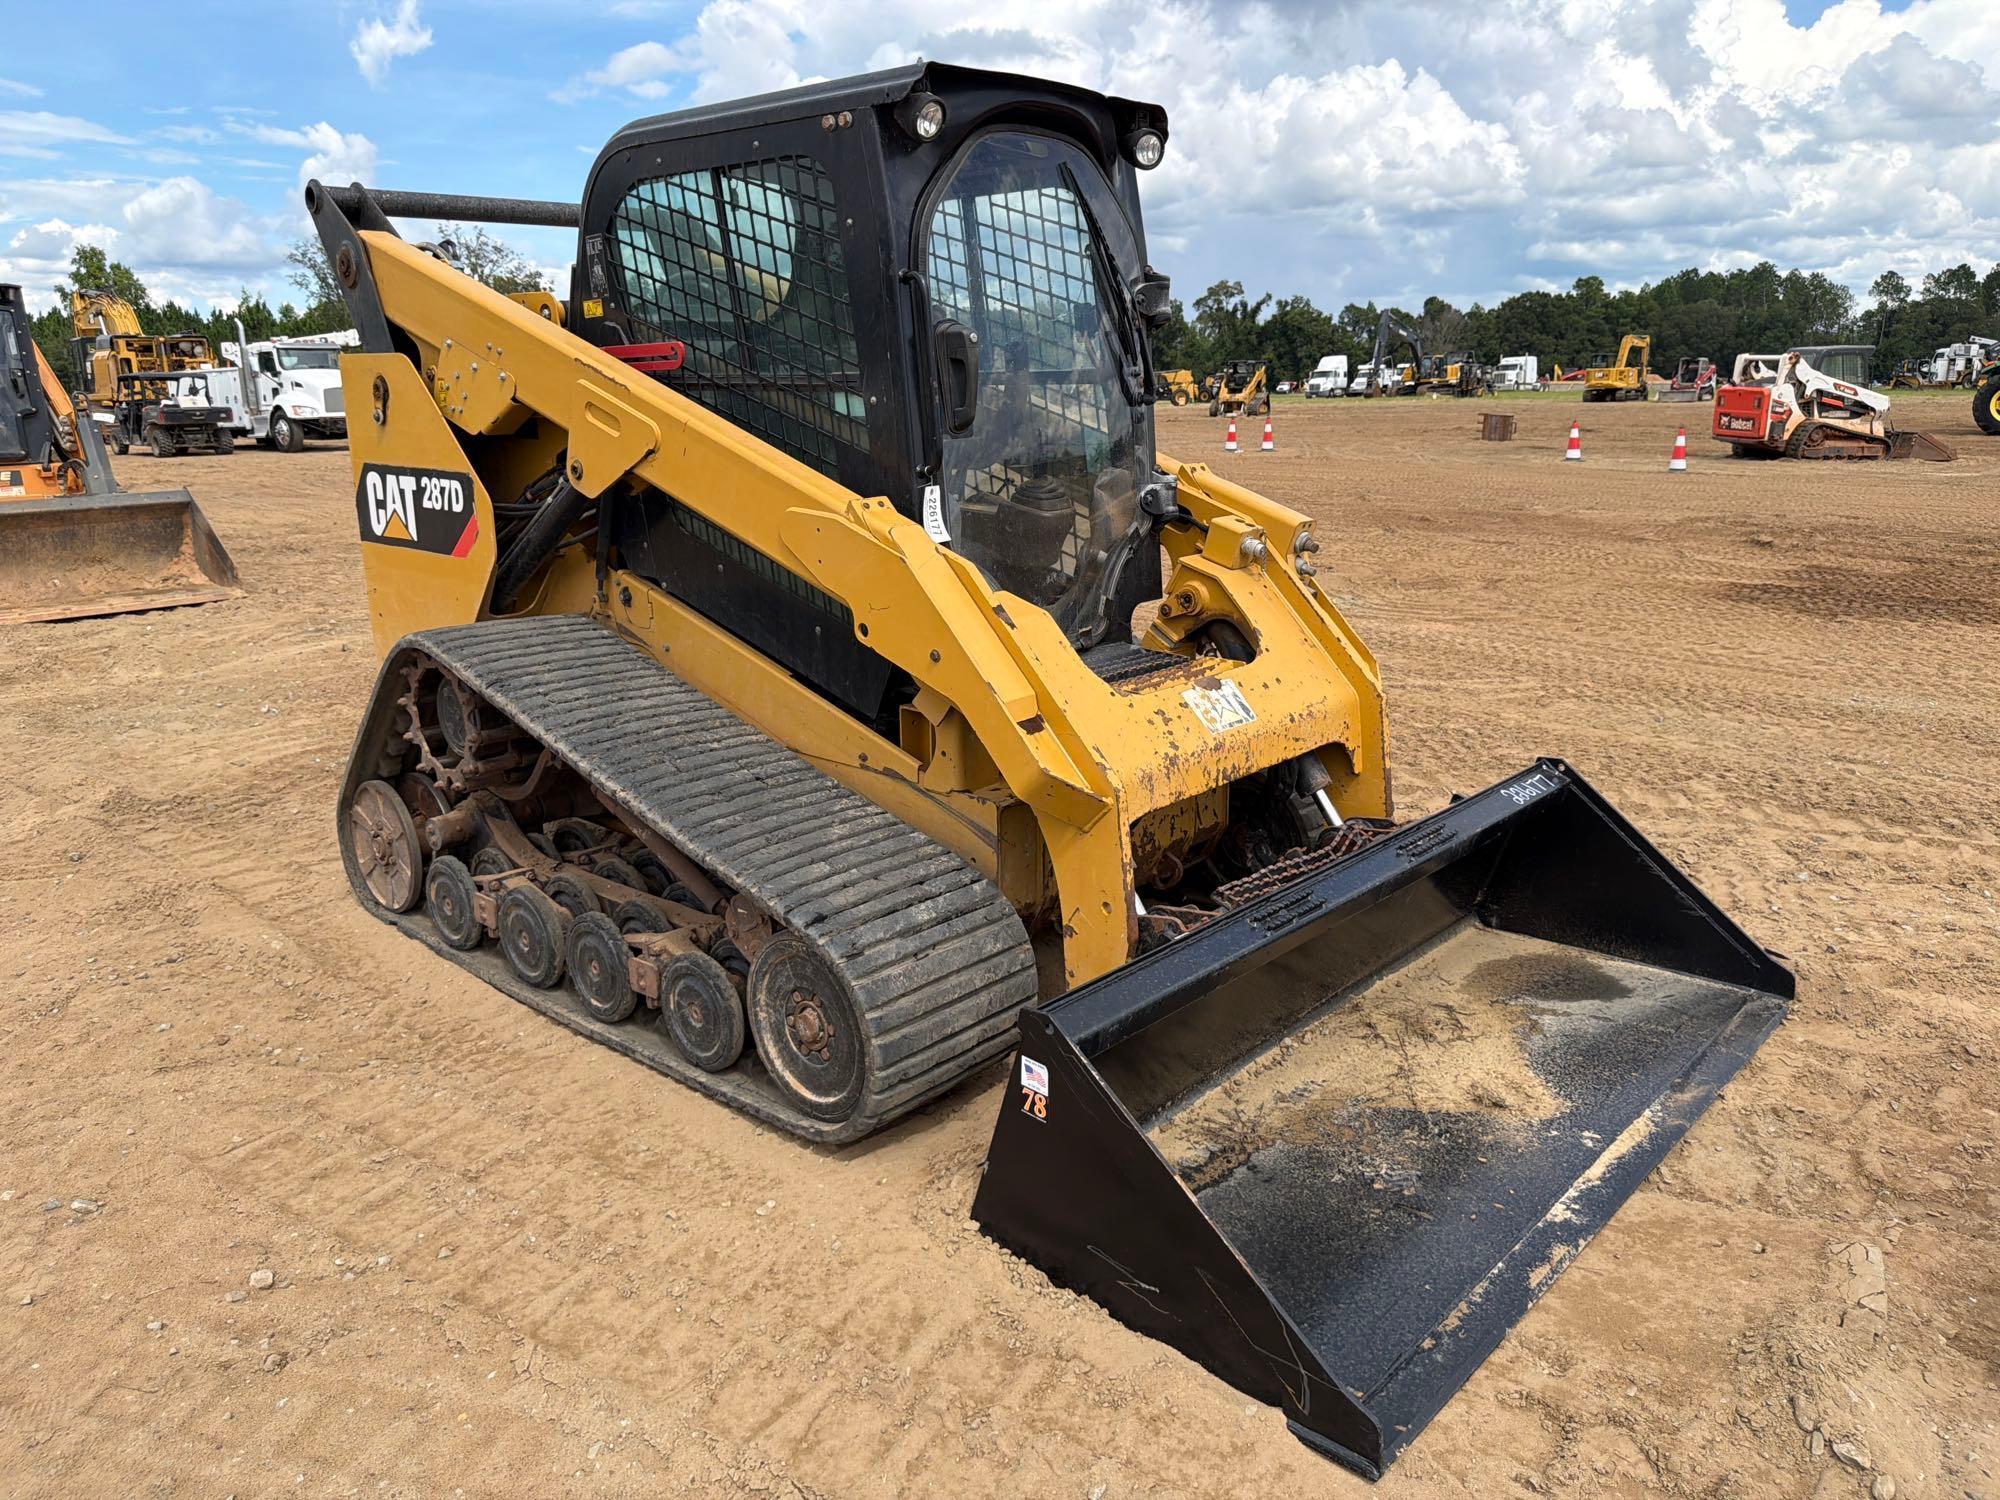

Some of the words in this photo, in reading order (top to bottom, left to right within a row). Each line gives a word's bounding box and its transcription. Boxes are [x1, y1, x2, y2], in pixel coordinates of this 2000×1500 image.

[1730, 418, 1754, 430] Bobcat
[366, 471, 418, 541] CAT
[420, 476, 464, 512] 287D
[928, 497, 943, 535] 226177
[1500, 774, 1556, 805] 226177
[1022, 1086, 1047, 1118] 78
